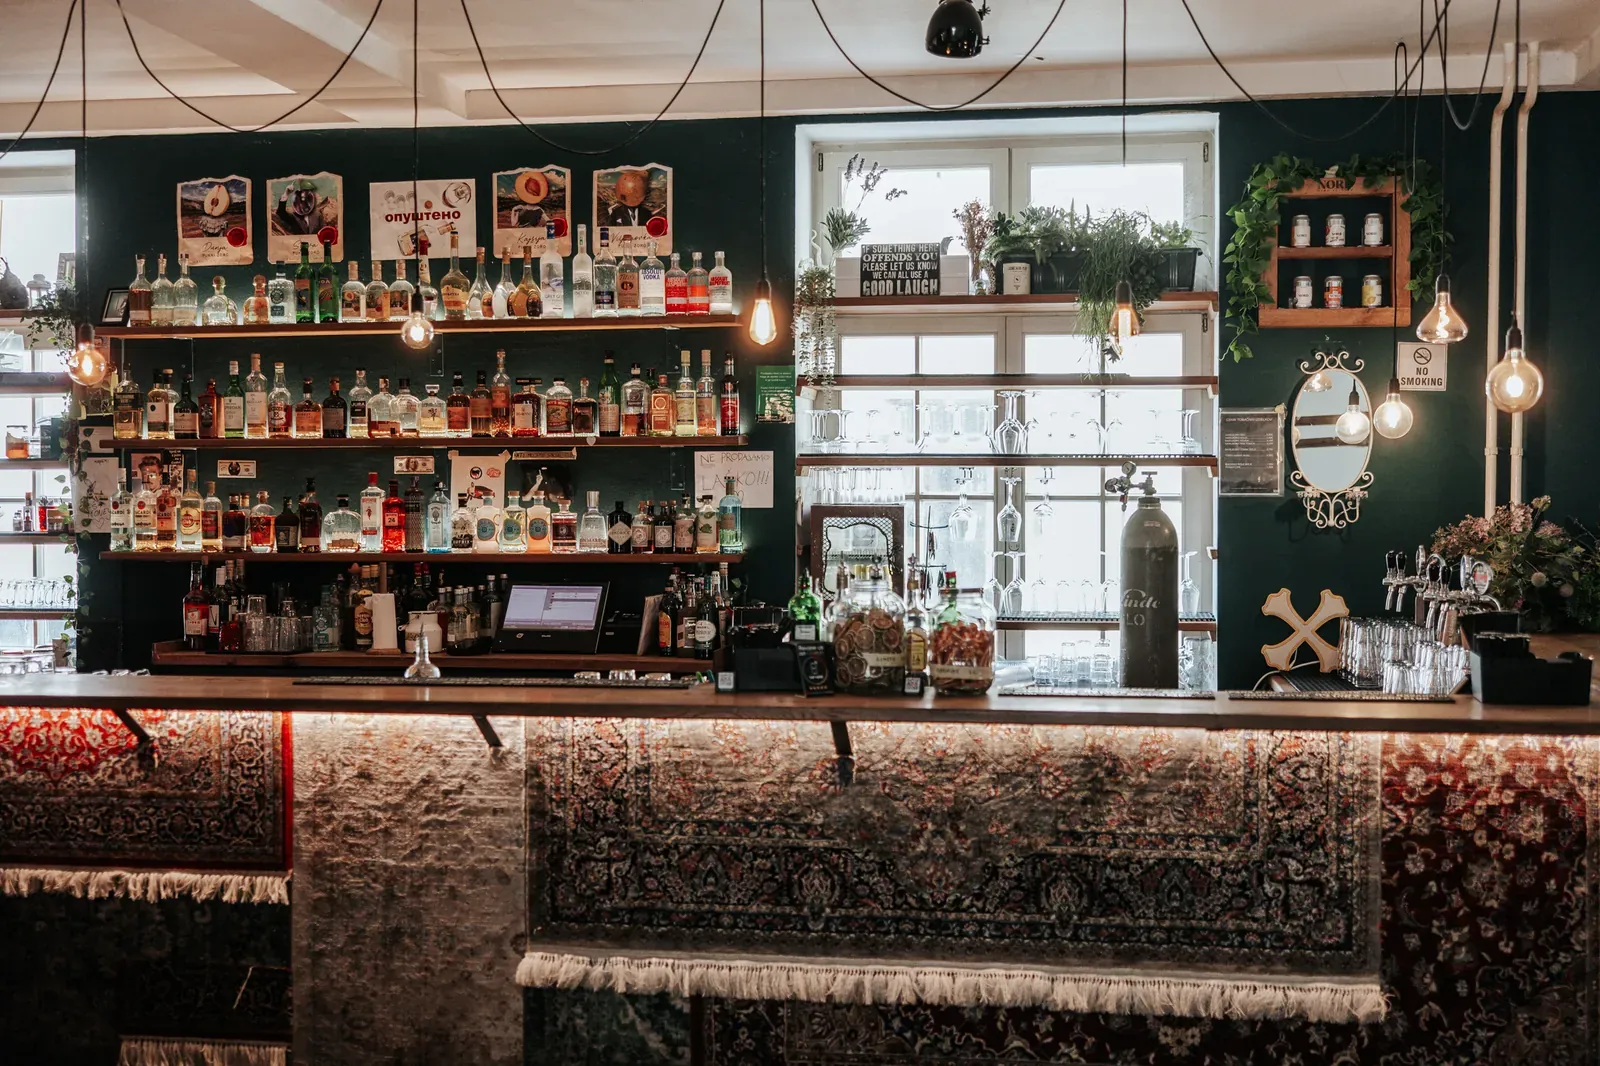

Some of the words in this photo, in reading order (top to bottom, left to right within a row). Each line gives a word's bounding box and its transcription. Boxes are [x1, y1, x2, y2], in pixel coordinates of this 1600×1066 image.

[384, 210, 461, 224] опуштено
[863, 245, 870, 253] IF
[872, 243, 916, 253] SOMETHING
[918, 243, 938, 252] HERE
[862, 252, 913, 262] OFFENDS
[915, 252, 938, 261] YOU
[862, 262, 888, 271] PLEASE
[890, 262, 903, 271] LET
[905, 261, 915, 270] US
[917, 261, 938, 270] KNOW
[872, 271, 882, 279] WE
[883, 271, 897, 279] CAN
[897, 271, 909, 279] ALL
[910, 271, 922, 279] USE
[862, 279, 894, 296] GOOD
[896, 279, 938, 296] LAUGH
[1416, 367, 1428, 376] NO
[1400, 377, 1443, 386] SMOKING
[700, 453, 715, 465] NE
